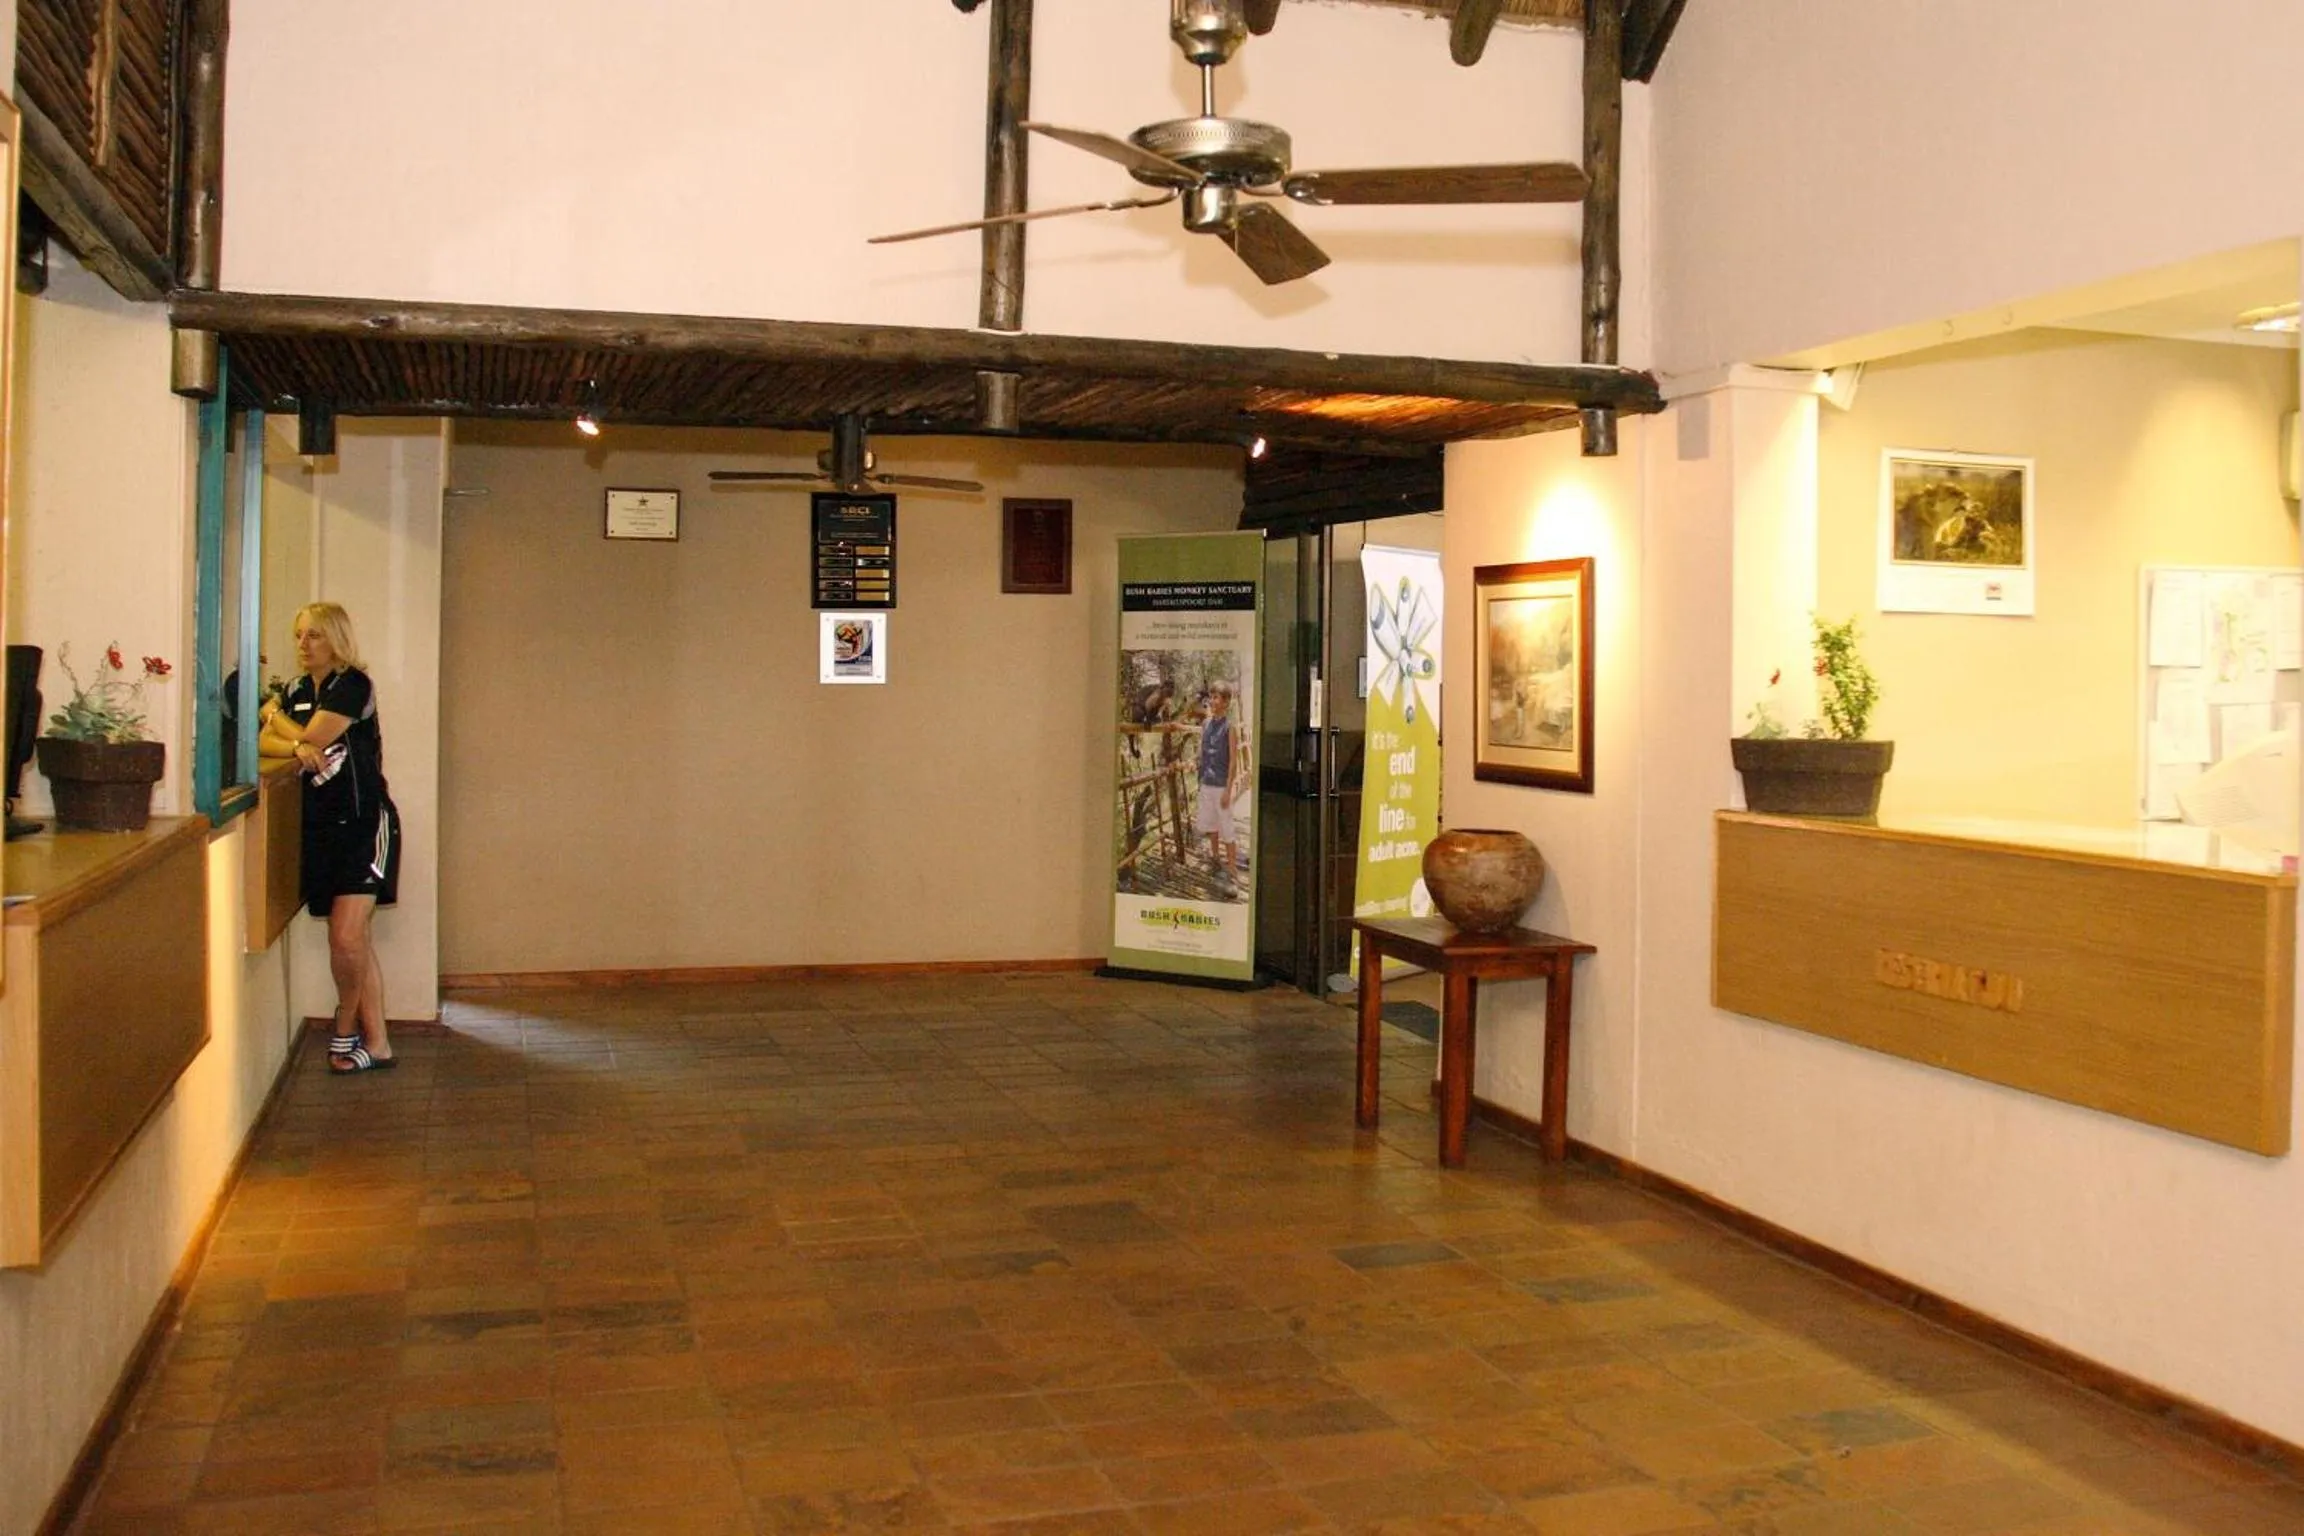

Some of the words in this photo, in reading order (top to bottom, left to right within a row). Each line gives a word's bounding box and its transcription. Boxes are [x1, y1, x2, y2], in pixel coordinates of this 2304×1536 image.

[1125, 587, 1145, 596] BUSH
[1147, 587, 1173, 596] BABIES
[1174, 586, 1207, 595] MONKEY
[1208, 585, 1253, 594] SANCTUARY
[1389, 745, 1416, 776] end
[1379, 802, 1404, 833] line
[1368, 840, 1393, 863] adult
[1140, 909, 1170, 921] BUSH
[1180, 913, 1221, 926] BABIES
